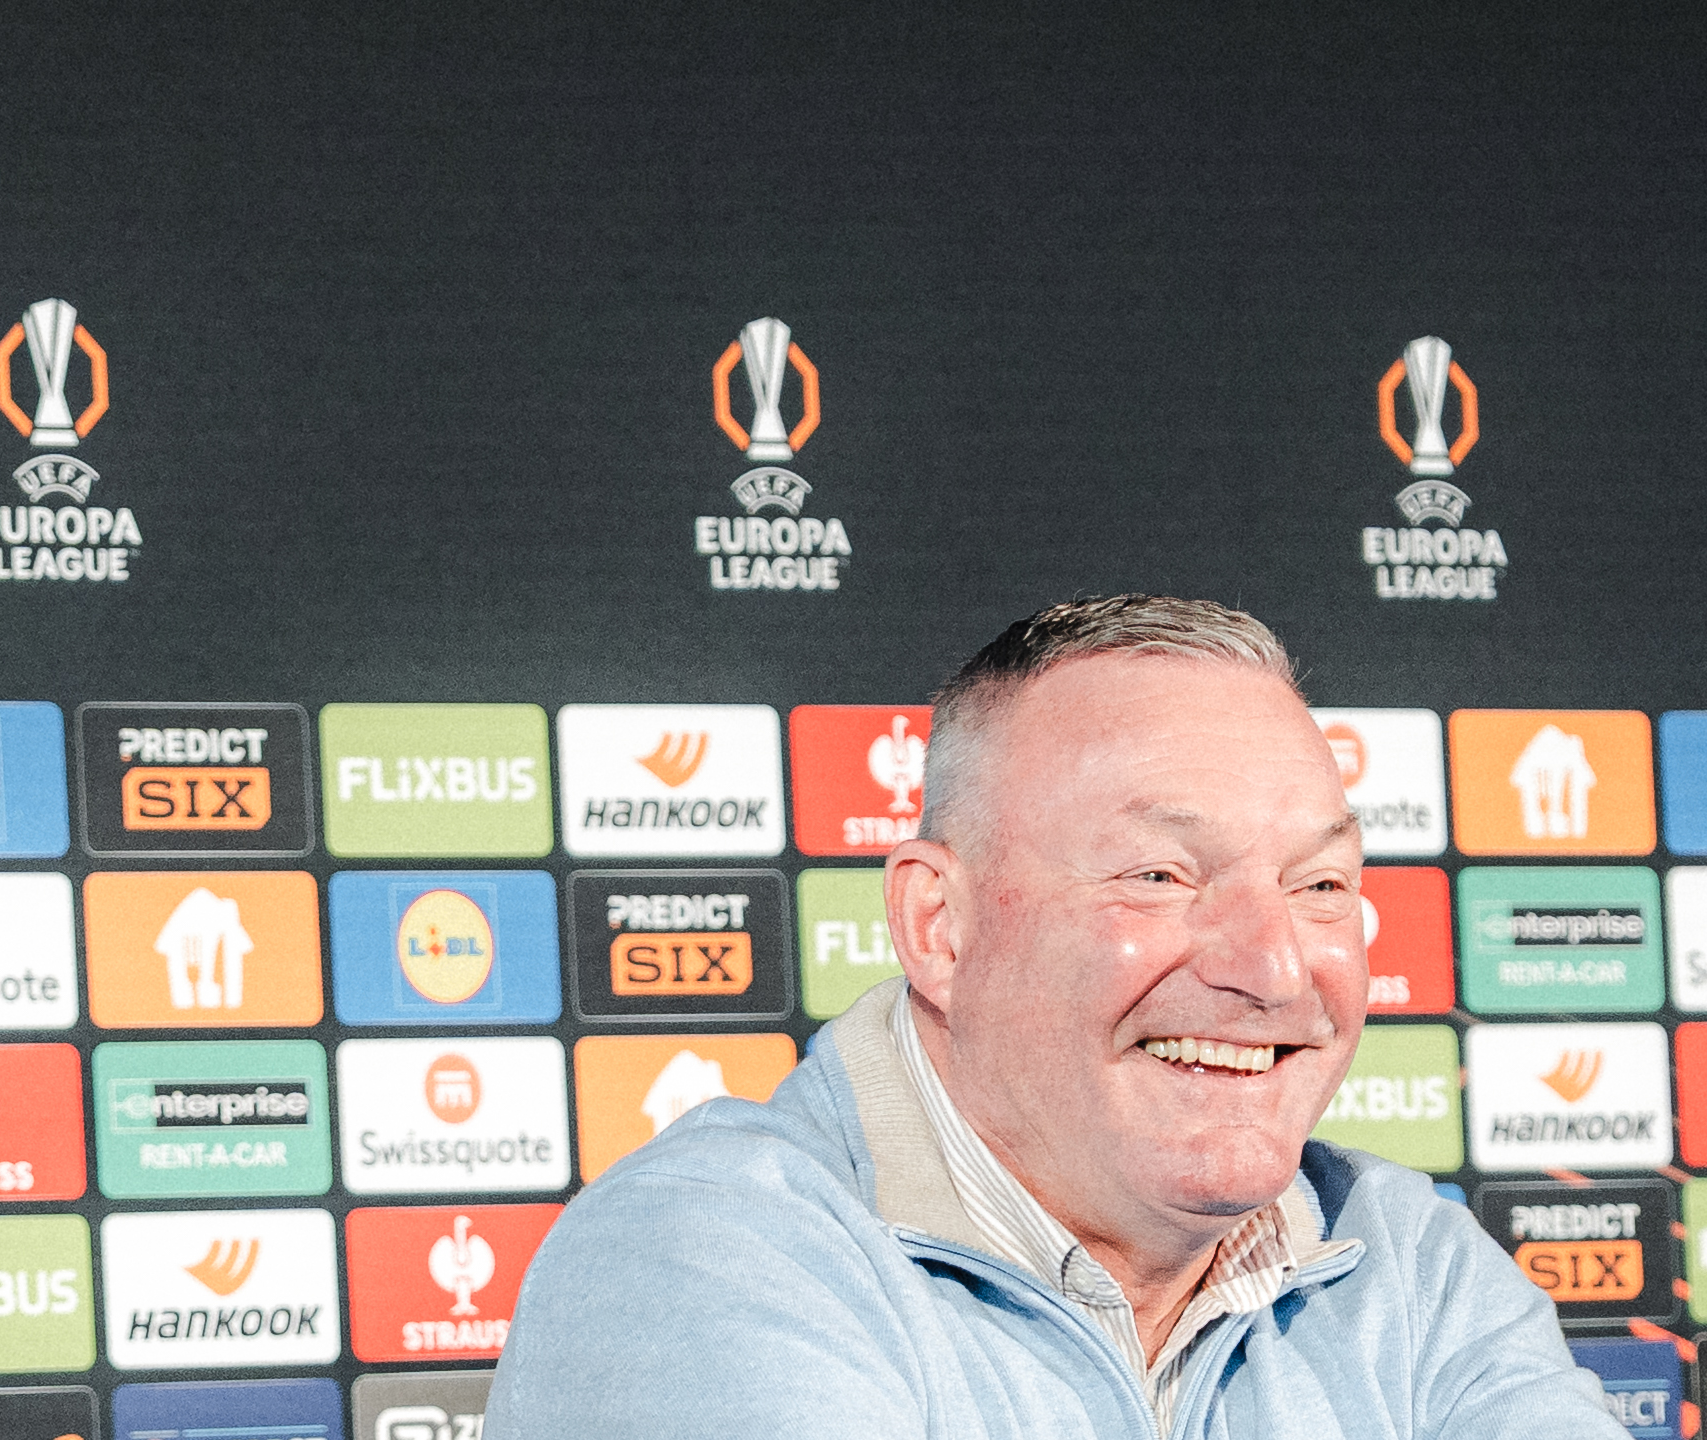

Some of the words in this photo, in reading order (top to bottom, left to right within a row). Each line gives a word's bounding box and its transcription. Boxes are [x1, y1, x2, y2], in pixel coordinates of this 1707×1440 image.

[18, 462, 93, 495] UEFA
[737, 475, 805, 505] UEFA
[695, 516, 853, 556] EUROPA
[1361, 527, 1509, 566] EUROPA
[709, 556, 841, 590] LEAGUE
[1376, 565, 1498, 600] LEAGUE
[119, 728, 269, 763] PREDICT
[138, 779, 253, 819] SIX
[607, 894, 750, 931] PREDICT
[1483, 909, 1646, 946] enterprise
[627, 945, 738, 984] SIX
[121, 1085, 310, 1125] enterprise
[139, 1141, 288, 1170] RENT-A-CAR
[358, 1130, 553, 1173] Swissquote
[1511, 1203, 1641, 1240] PREDICT
[1529, 1253, 1628, 1291] SIX
